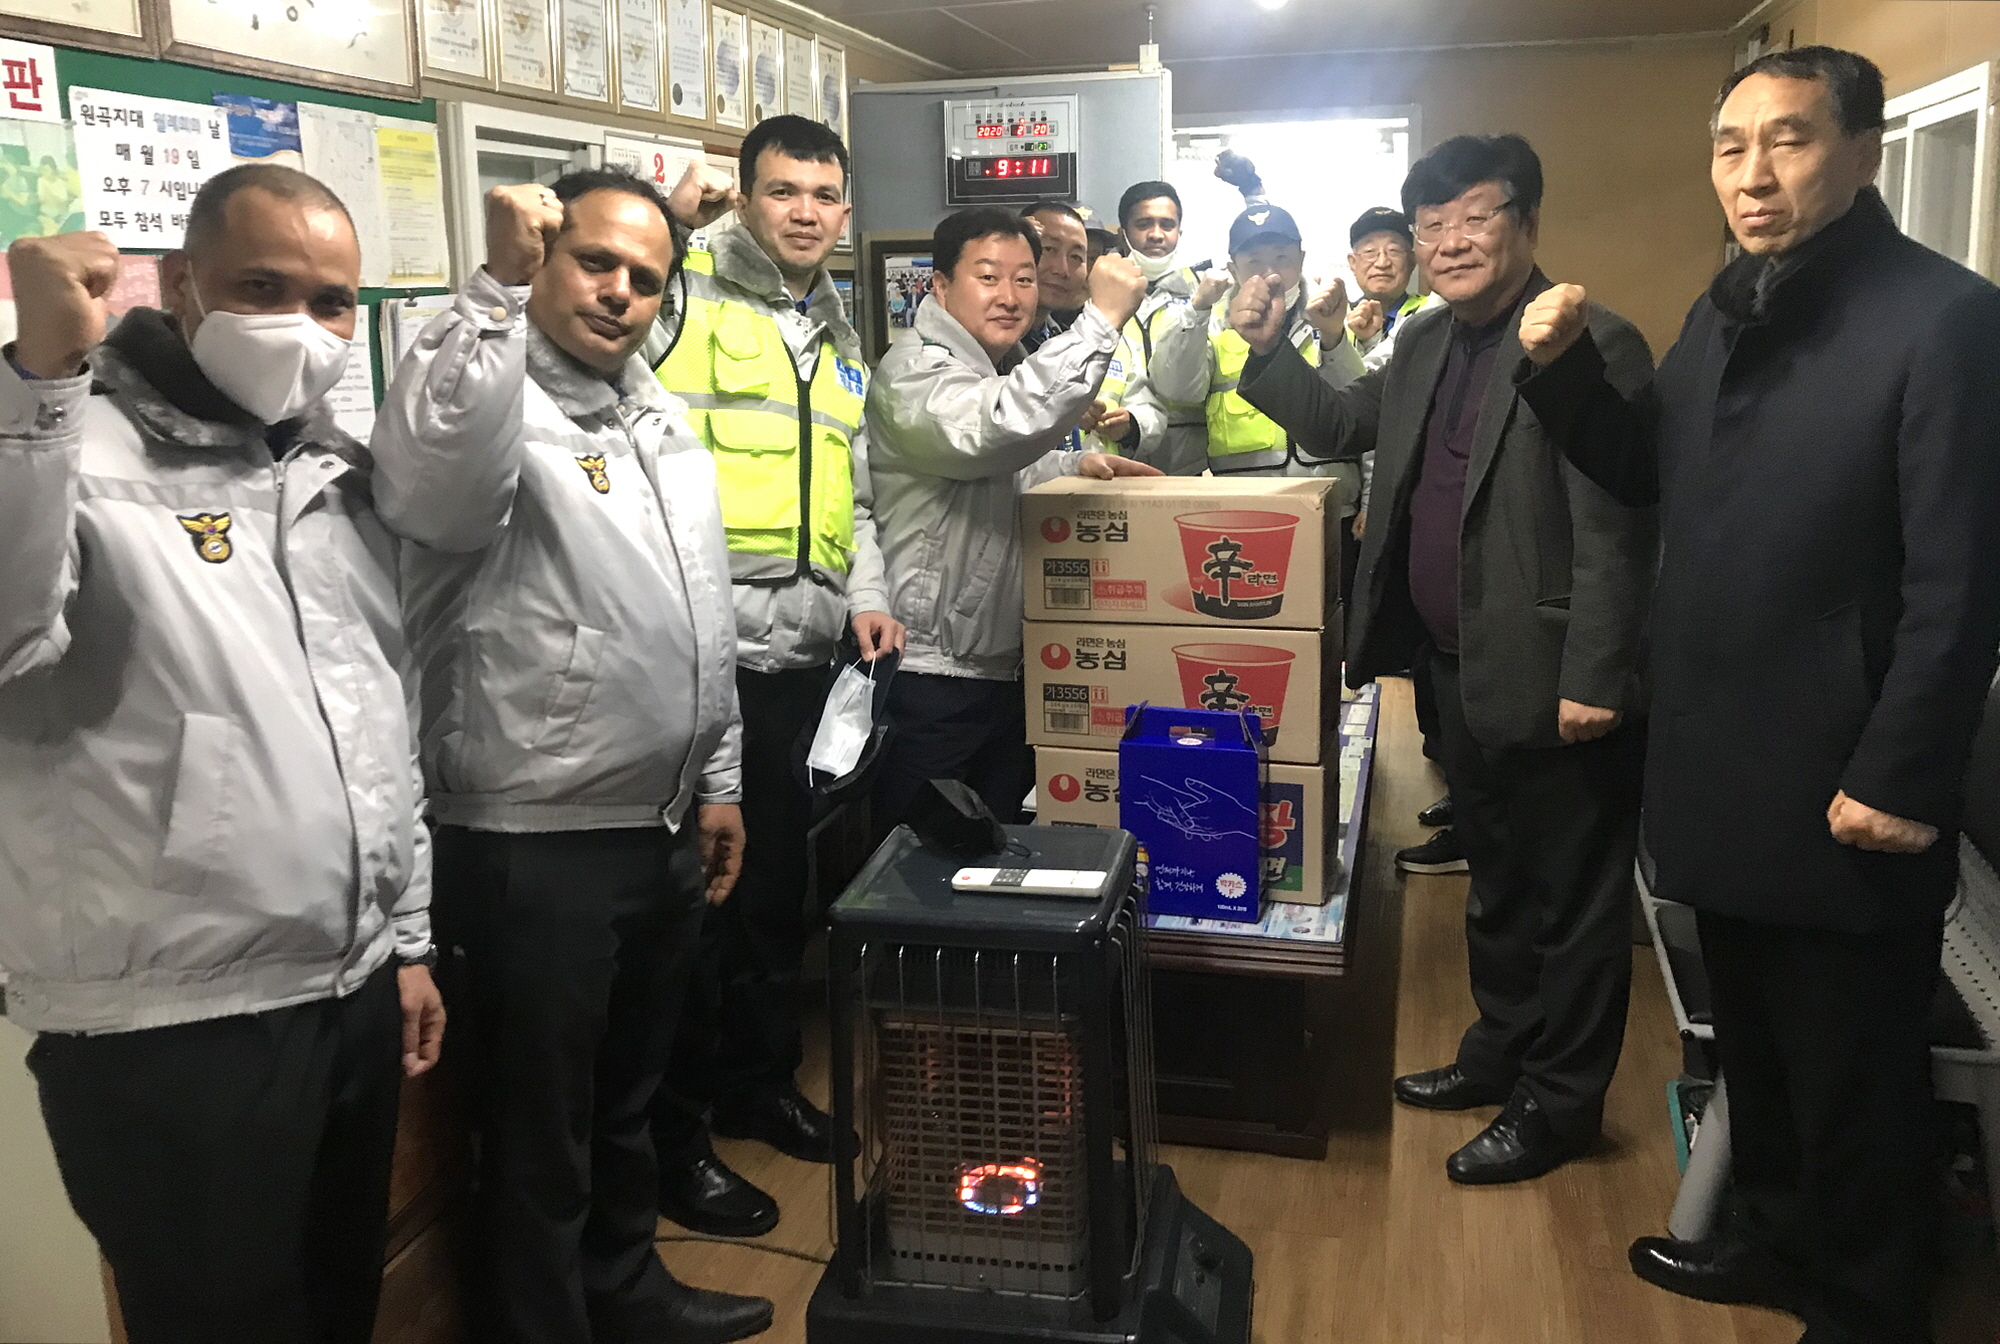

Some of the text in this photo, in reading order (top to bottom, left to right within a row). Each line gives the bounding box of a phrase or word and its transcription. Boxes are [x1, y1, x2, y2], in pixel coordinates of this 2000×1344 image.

[1, 57, 43, 112] 판
[80, 104, 144, 128] 원곡지대
[208, 120, 221, 139] 날
[978, 125, 1003, 137] 2020
[1016, 125, 1025, 136] 2
[1033, 123, 1047, 135] 20
[116, 143, 201, 170] 매 월 19 일
[654, 153, 665, 184] 2
[997, 158, 1049, 177] 9:11
[103, 176, 132, 196] 오후
[140, 179, 150, 196] 7
[99, 210, 128, 229] 모두
[134, 211, 164, 233] 참석
[1076, 510, 1128, 520] 라면은 농심
[1075, 521, 1129, 543] 농심
[1045, 561, 1088, 575] 가3556
[1203, 537, 1255, 605] 辛
[1246, 572, 1279, 586] 라면
[1107, 585, 1143, 596] 취급주의
[1076, 637, 1126, 648] 라면은 농심
[1075, 648, 1127, 671] 농심
[1045, 685, 1088, 700] 가3556
[1085, 767, 1116, 780] 라면은
[1220, 878, 1243, 889] 박카스
[1229, 888, 1235, 896] F
